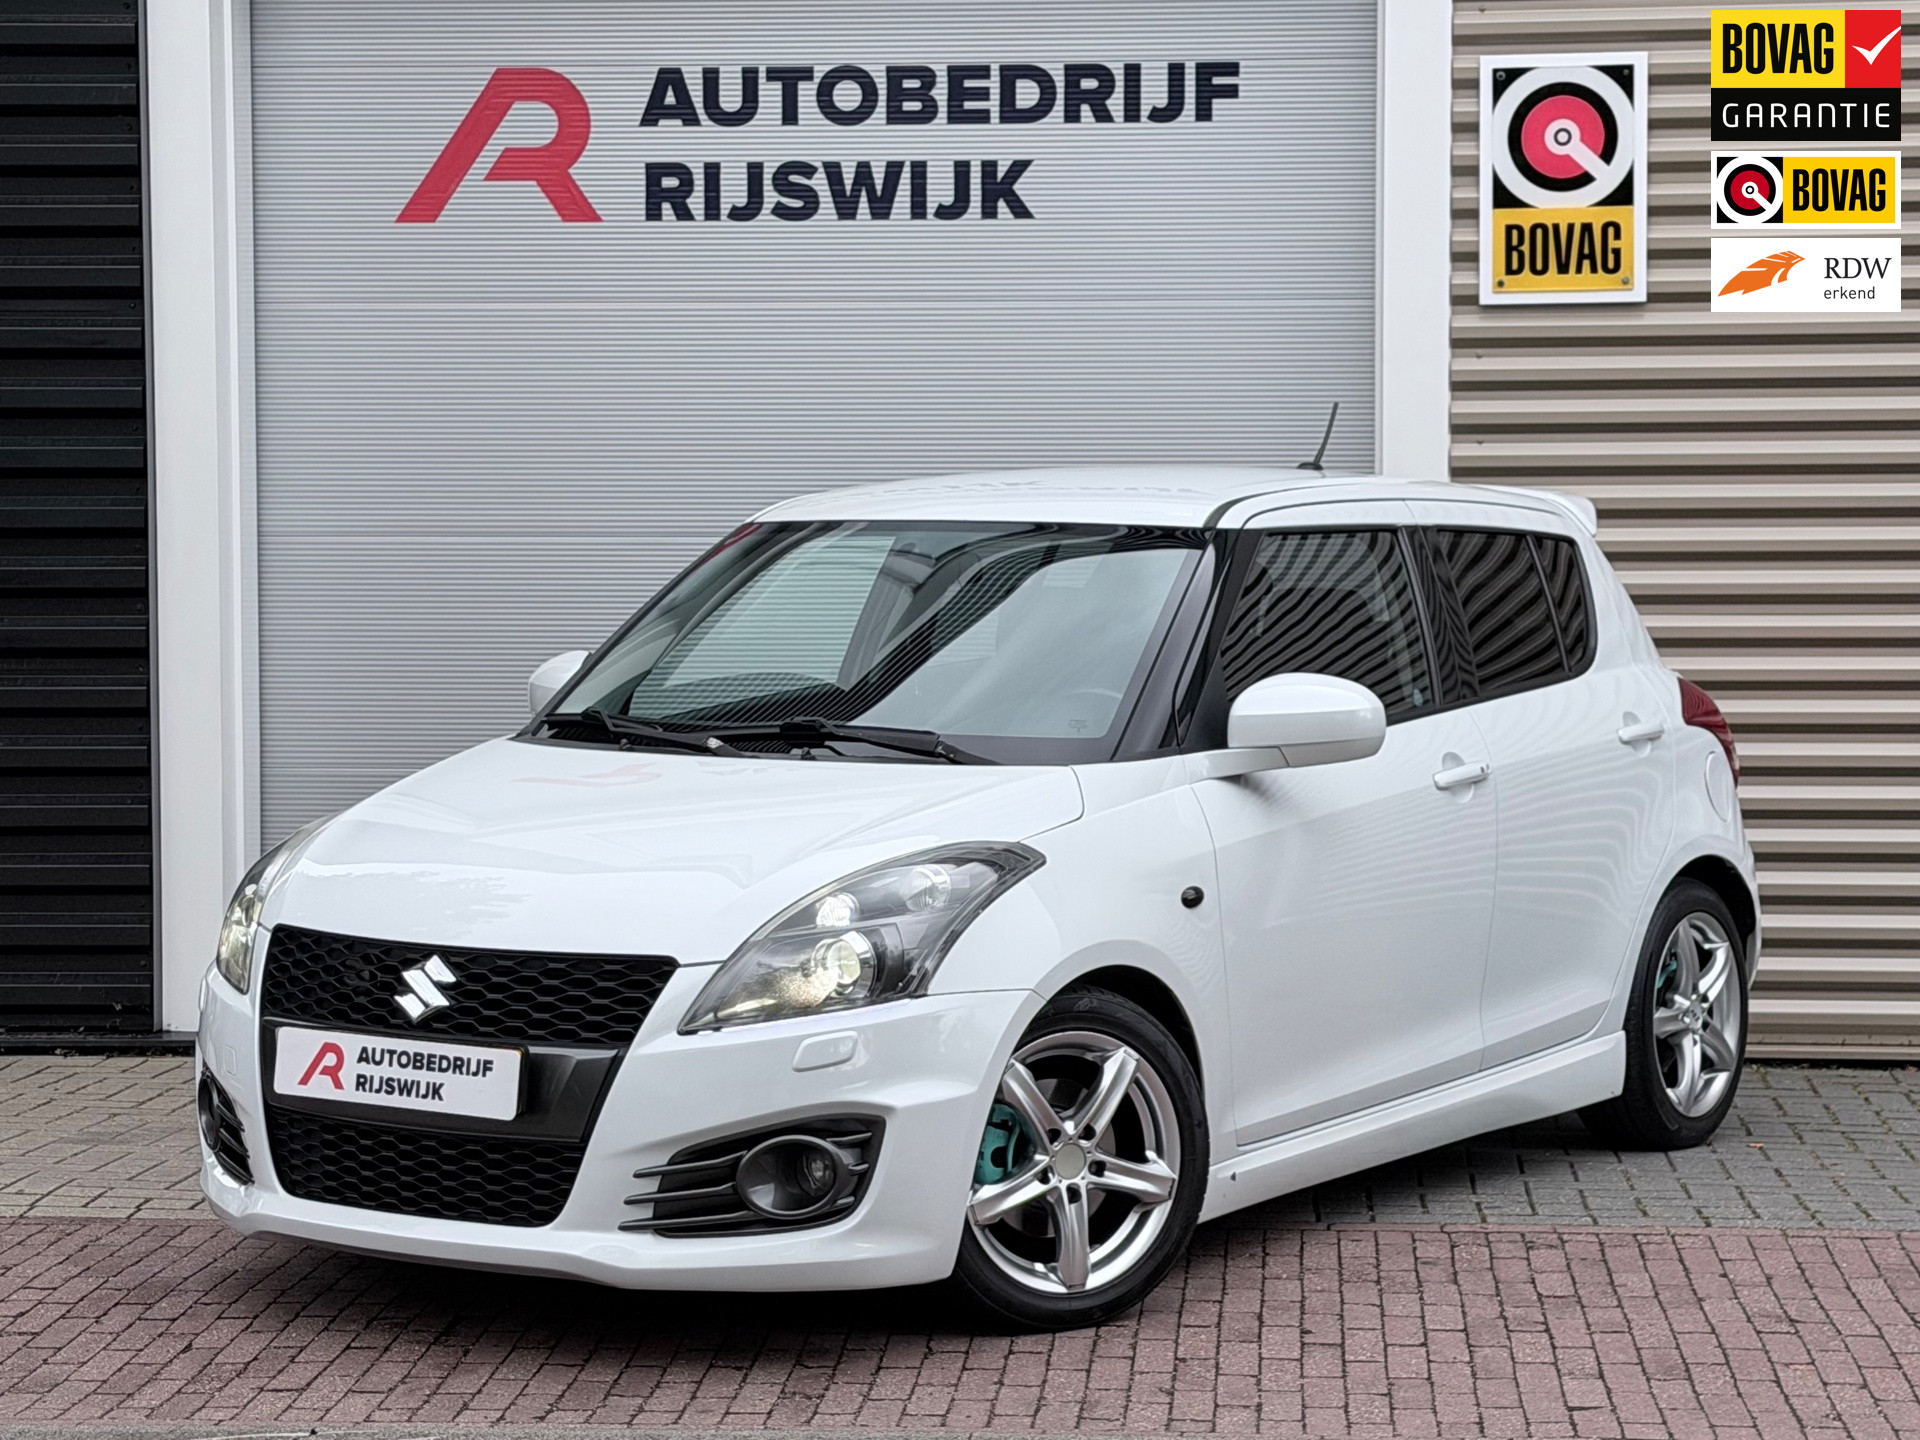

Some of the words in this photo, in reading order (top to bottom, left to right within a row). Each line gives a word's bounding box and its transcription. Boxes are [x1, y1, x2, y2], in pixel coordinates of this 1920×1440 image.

[639, 61, 1241, 127] AUTOBEDRIJF
[644, 159, 1036, 222] RIJSWIJK
[1504, 220, 1622, 277] BOVAG
[355, 1073, 445, 1102] RIJSWIJK
[356, 1046, 494, 1078] AUTOBEDRIJF
